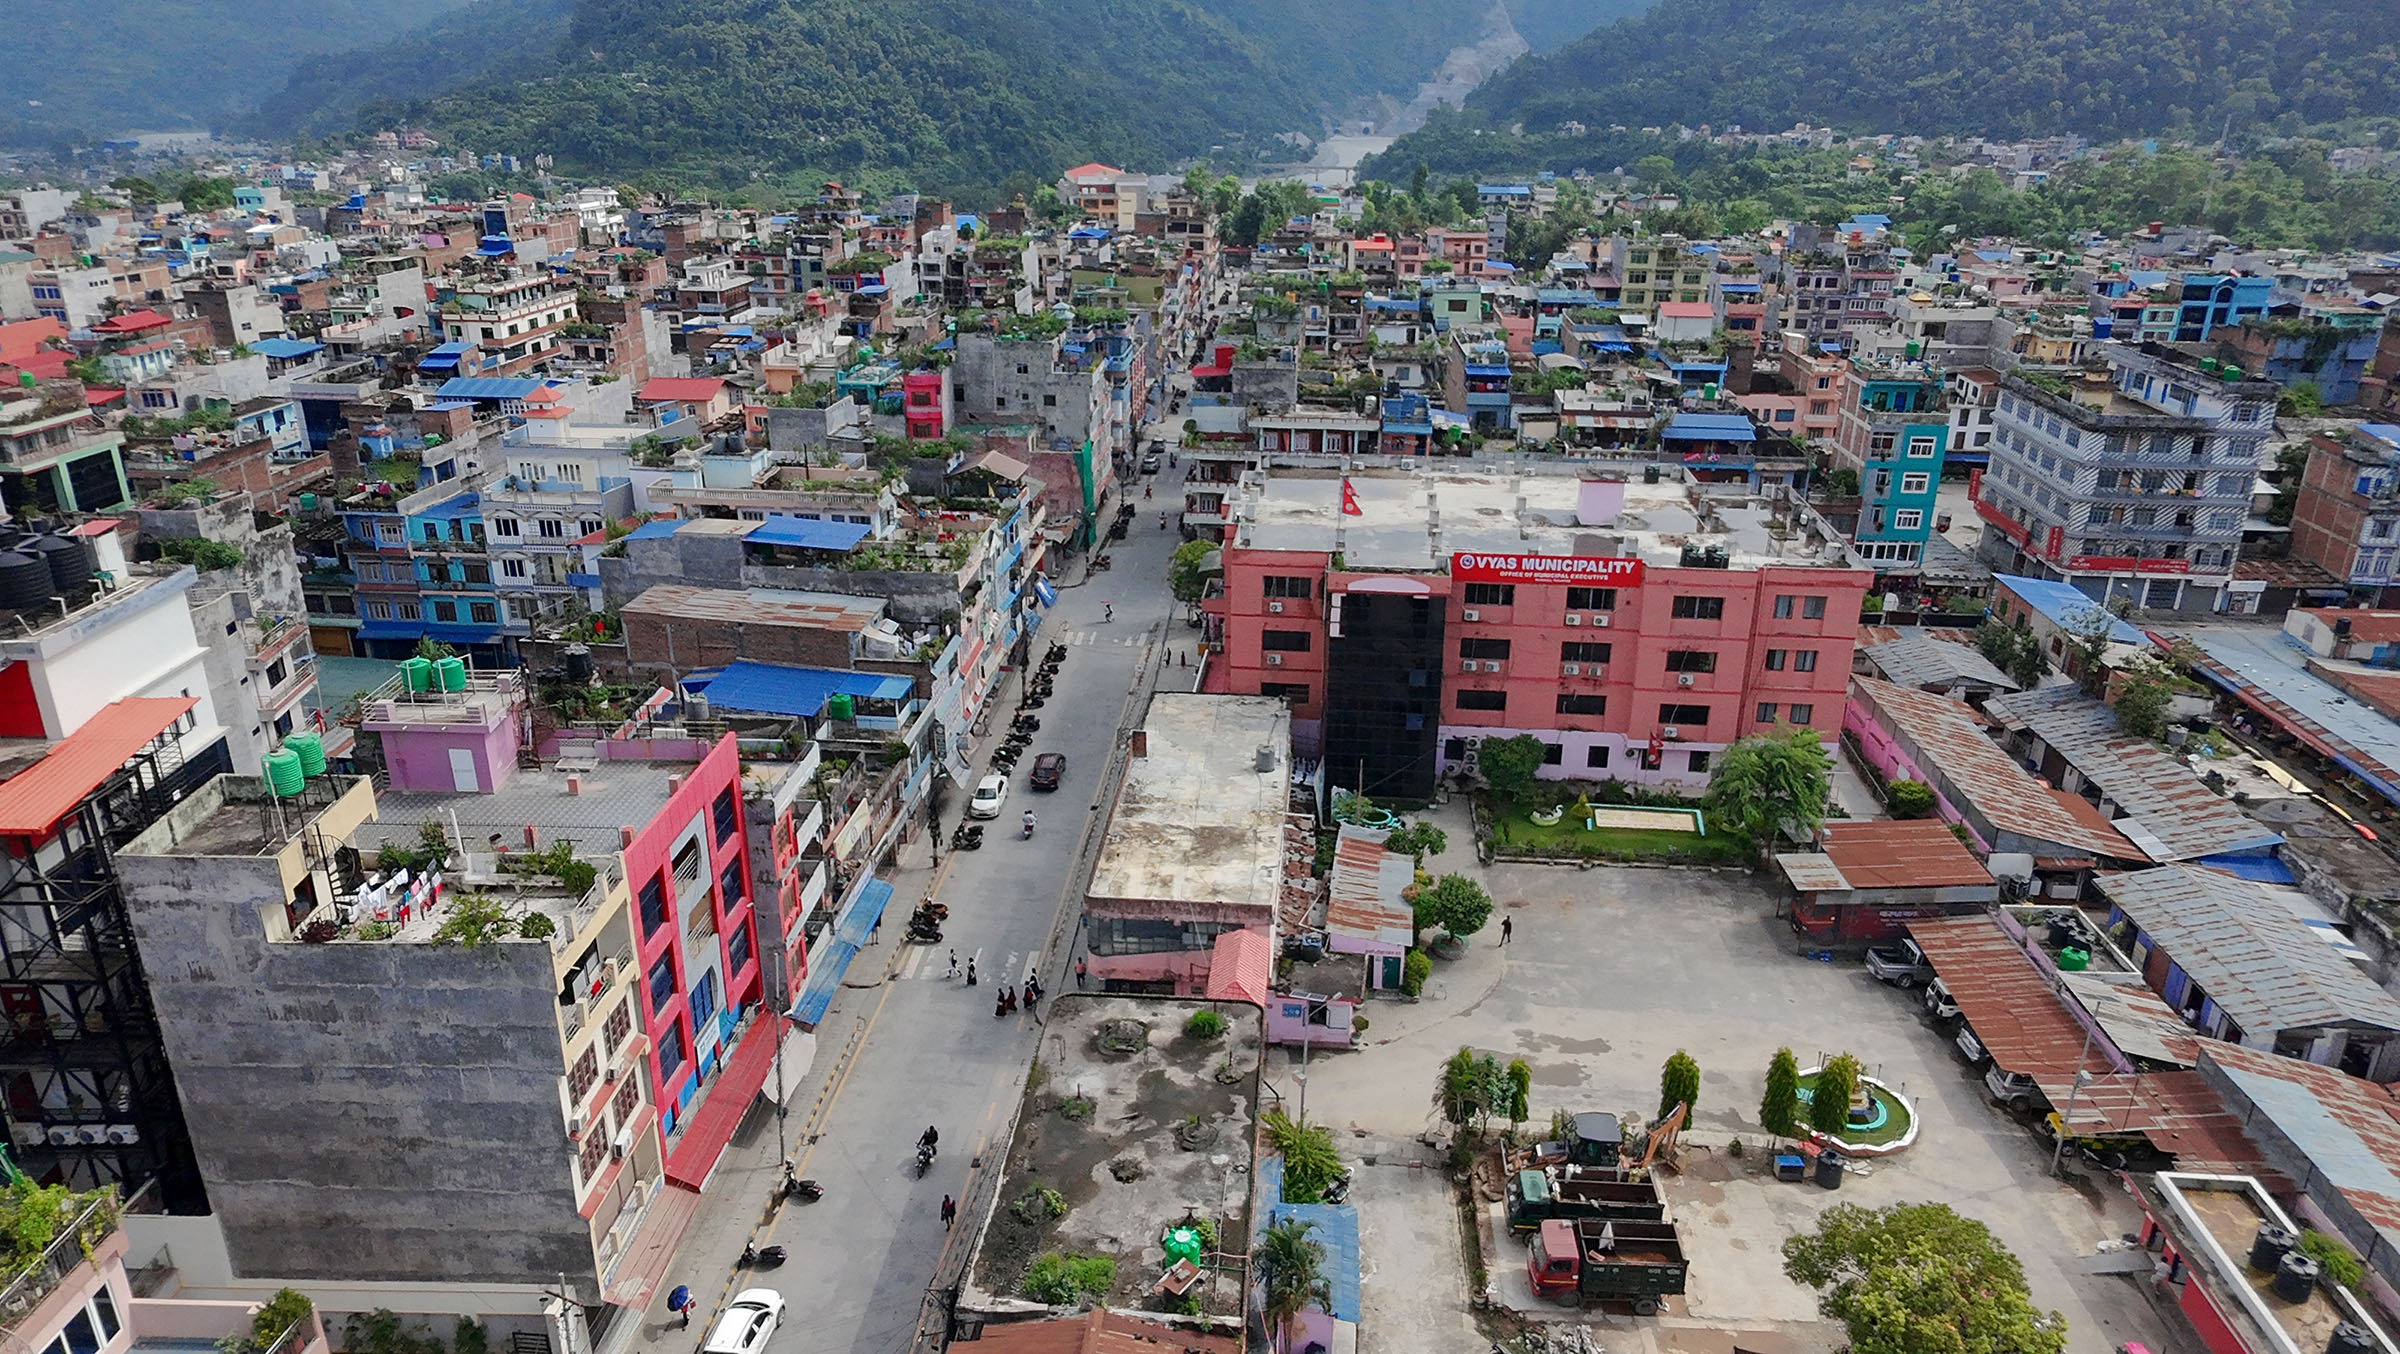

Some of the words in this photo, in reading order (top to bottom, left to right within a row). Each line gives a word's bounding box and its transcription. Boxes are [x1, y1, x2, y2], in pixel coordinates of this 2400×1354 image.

[1476, 556, 1517, 570] VYAS
[1522, 558, 1636, 574] MUNICIPALITY
[1570, 573, 1608, 581] EXECUTIVE
